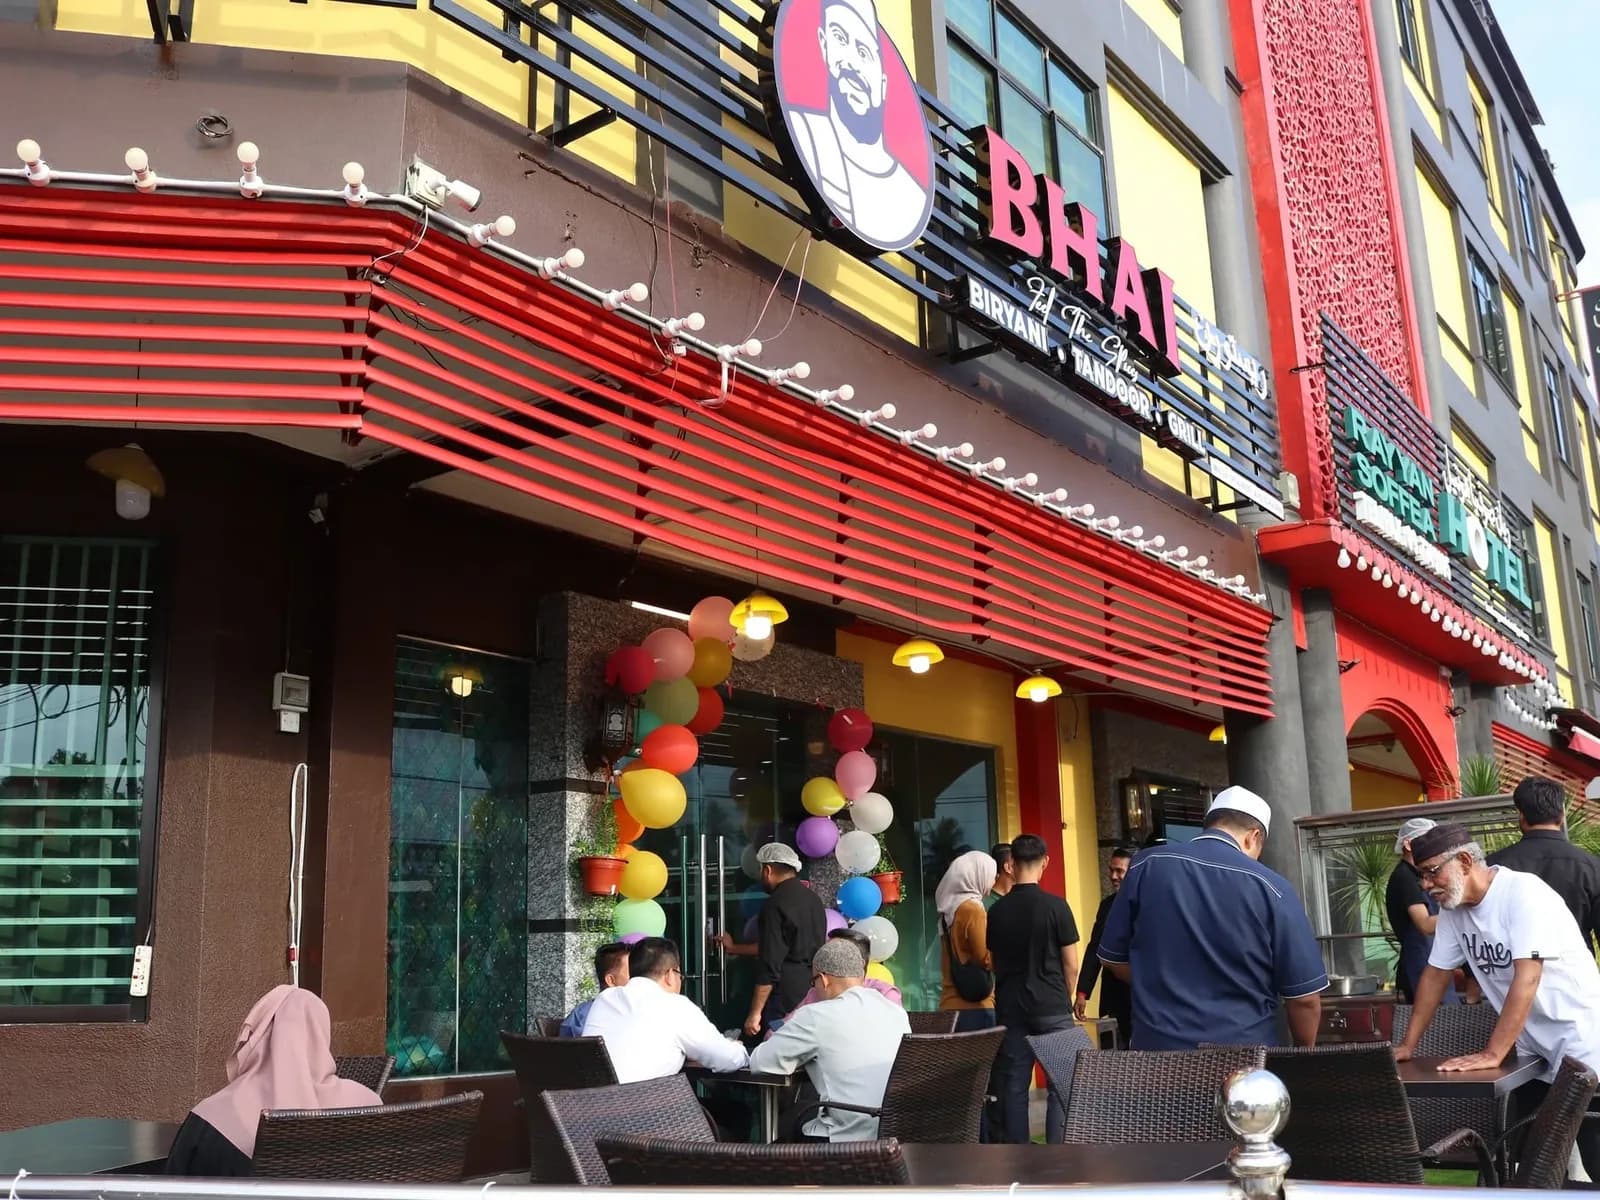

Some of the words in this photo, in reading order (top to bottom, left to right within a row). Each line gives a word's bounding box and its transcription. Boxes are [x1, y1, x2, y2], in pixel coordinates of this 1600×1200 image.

[982, 125, 1182, 375] BHAI
[968, 276, 1050, 356] BIRYANI
[1071, 344, 1154, 424] TANDOOR
[1167, 412, 1206, 460] GRILL
[1061, 304, 1093, 341] The
[1346, 405, 1436, 508] RAYYAN
[1352, 452, 1437, 542] SOFFEA
[1439, 491, 1533, 611] HOTEL
